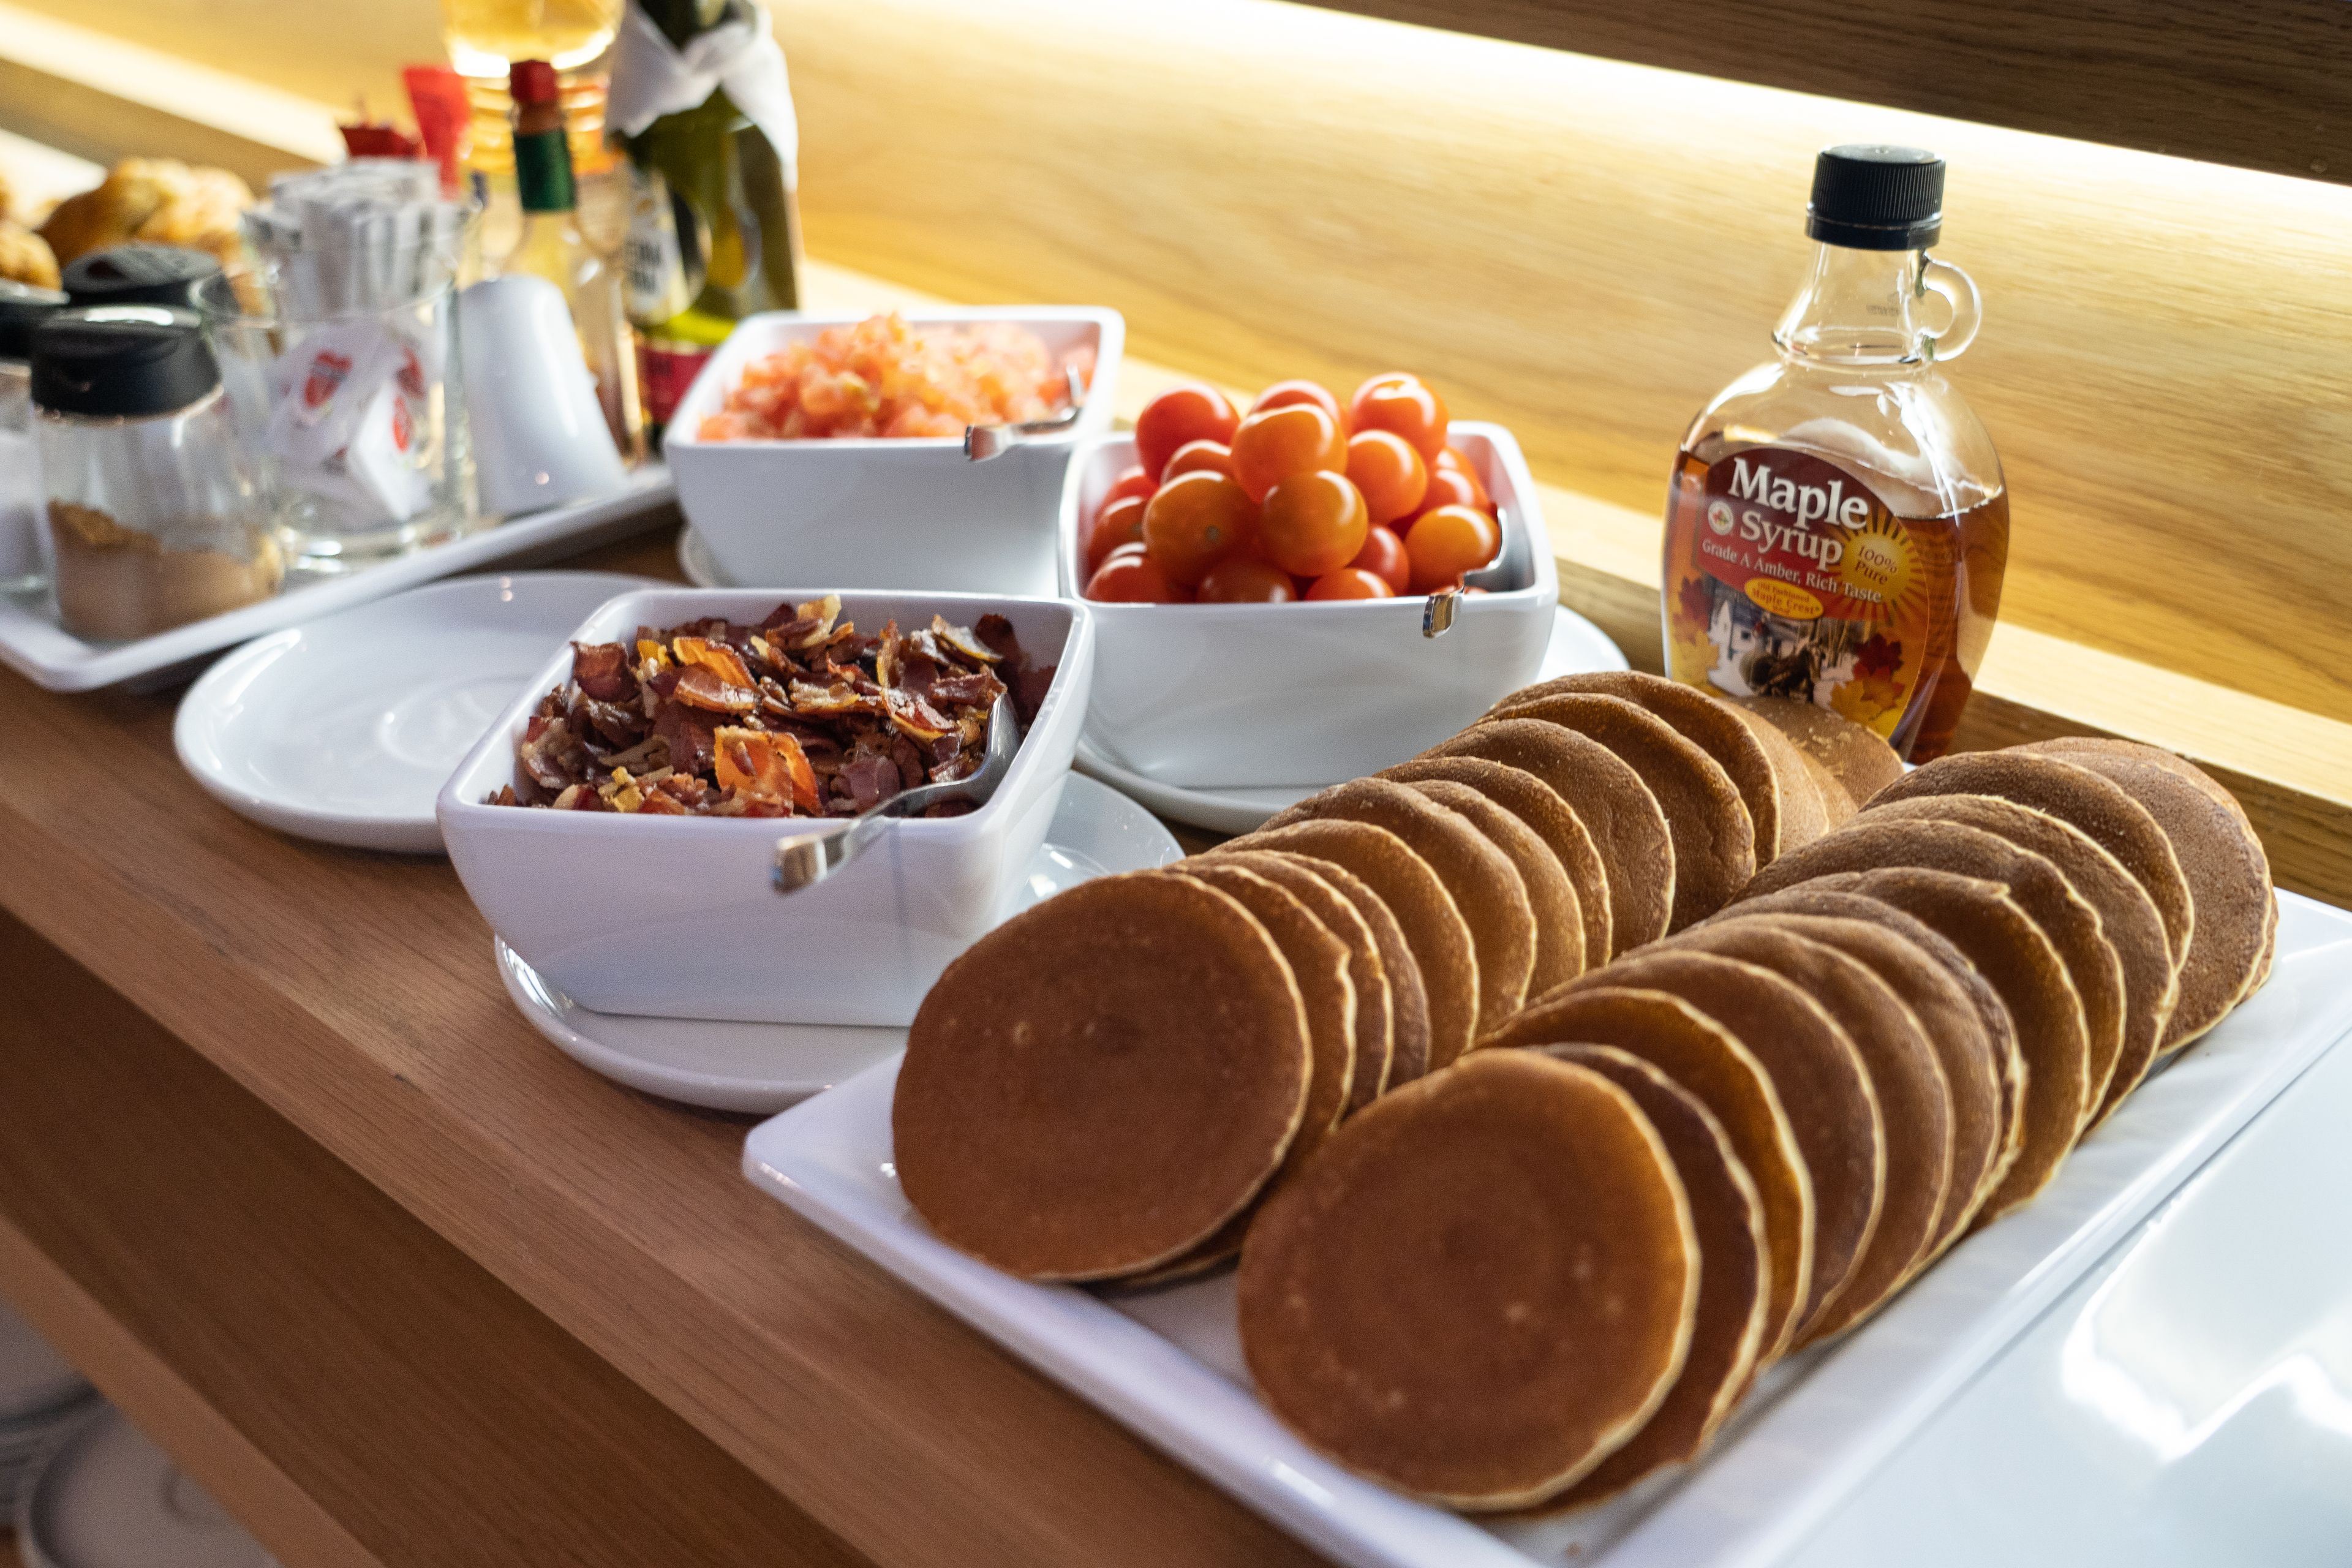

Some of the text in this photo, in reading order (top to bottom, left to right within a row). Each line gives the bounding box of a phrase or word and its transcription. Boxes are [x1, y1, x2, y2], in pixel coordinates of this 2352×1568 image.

[1727, 456, 1868, 530] Maple
[1702, 538, 1882, 603] Grade A Amber, Rich Taste
[1740, 510, 1843, 571] Syrup
[1858, 546, 1898, 573] 100%
[1855, 560, 1888, 585] Pure
